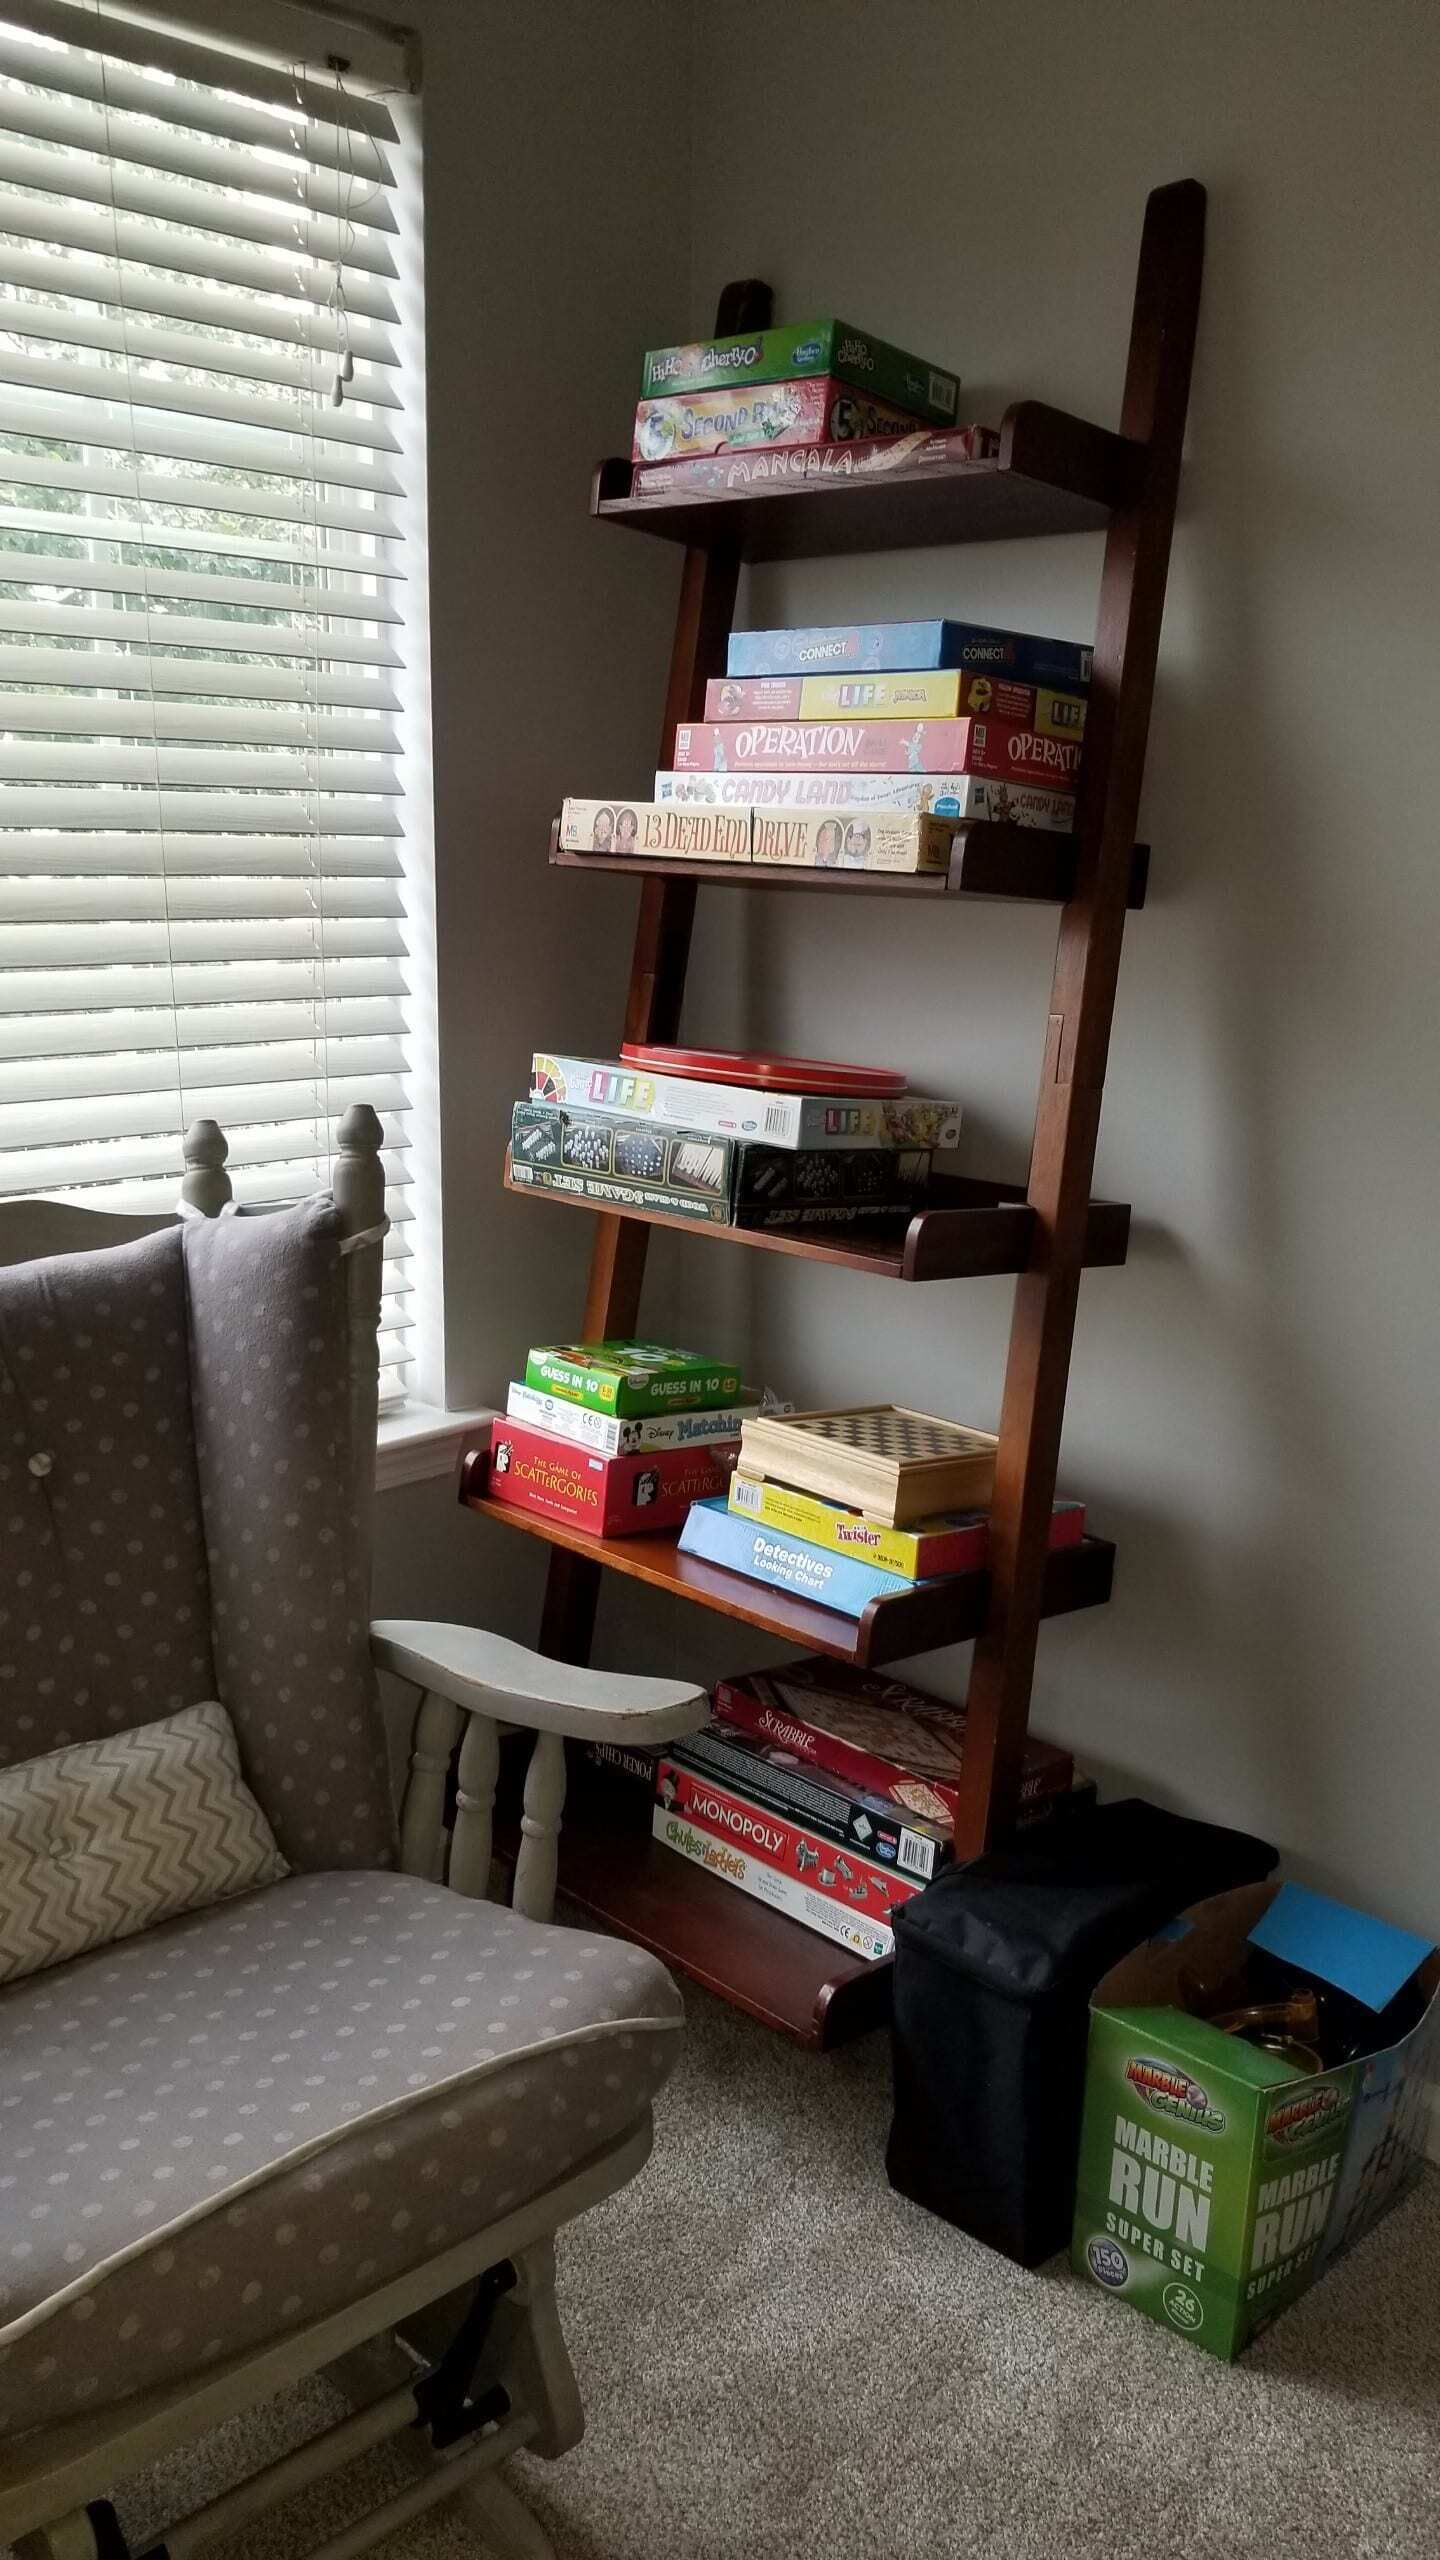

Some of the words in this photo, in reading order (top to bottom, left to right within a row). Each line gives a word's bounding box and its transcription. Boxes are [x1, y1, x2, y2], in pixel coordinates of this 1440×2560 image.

[799, 641, 848, 661] CONNECT
[962, 647, 1004, 660] CONNECT
[838, 682, 886, 708] LIFE
[735, 725, 865, 760] OPERATION
[1007, 732, 1082, 772] OPERATI
[721, 779, 792, 805] CANDY
[795, 779, 852, 806] LAND
[643, 813, 662, 850] 13
[749, 815, 809, 862] DRIVE
[591, 1071, 655, 1111] LIFE
[826, 1108, 876, 1136] LIFE
[552, 1172, 584, 1193] SET
[586, 1178, 633, 1202] GAME
[540, 1365, 570, 1385] GUESS
[571, 1374, 583, 1389] IN
[586, 1378, 599, 1393] 10
[650, 1380, 687, 1397] GUESS
[689, 1380, 702, 1393] IN
[705, 1378, 719, 1391] 10
[646, 1426, 675, 1441] Disney
[677, 1413, 742, 1441] Matchin
[534, 1455, 547, 1469] THE
[549, 1461, 569, 1477] GAME
[514, 1460, 599, 1507] SCATTERGORIES
[836, 1522, 882, 1547] Twister
[752, 1536, 834, 1579] Detectives
[753, 1555, 793, 1580] Looking
[794, 1569, 826, 1591] Chart
[757, 1709, 816, 1748] SCRABBLE
[623, 1753, 652, 1781] POKER
[692, 1793, 784, 1852] MONOPOLY
[839, 1923, 851, 1940] CE
[1126, 2057, 1189, 2099] MARBLE
[1150, 2088, 1226, 2133] GENIUS
[1114, 2114, 1214, 2193] MARBLE
[1258, 2152, 1341, 2214] MARBLE
[1109, 2147, 1211, 2254] RUN
[1251, 2181, 1336, 2272] RUN
[1091, 2245, 1125, 2271] 150
[1106, 2211, 1165, 2261] SUPER
[1170, 2248, 1205, 2283] SET
[1175, 2288, 1196, 2312] 26
